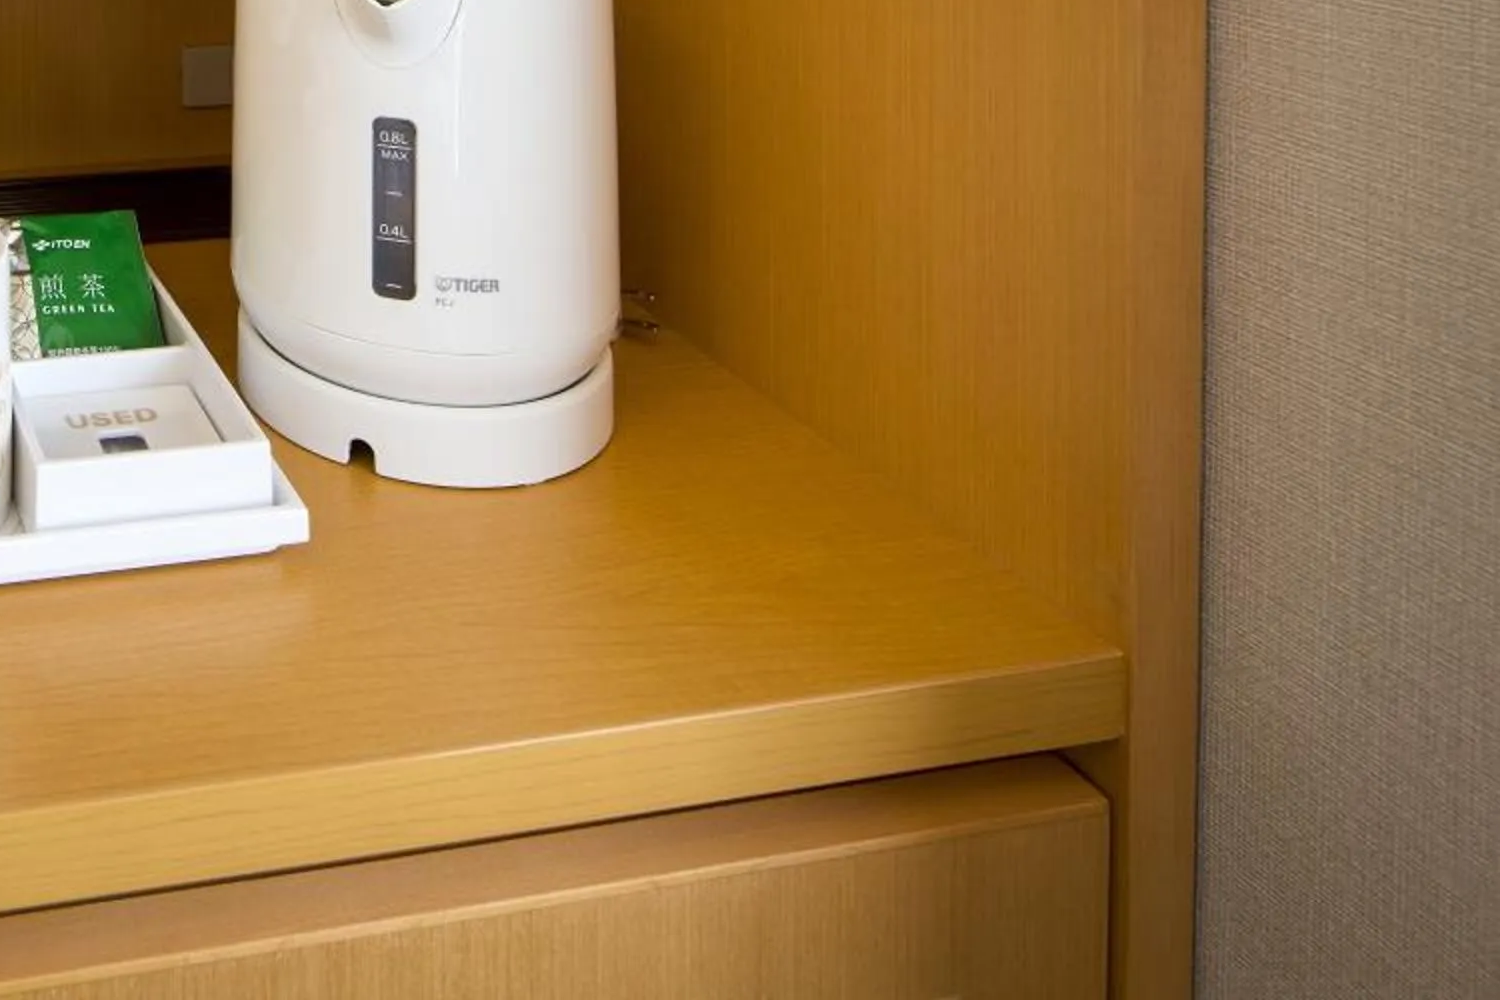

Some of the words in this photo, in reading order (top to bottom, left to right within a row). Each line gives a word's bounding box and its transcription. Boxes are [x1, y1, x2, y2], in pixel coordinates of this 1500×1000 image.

[379, 130, 409, 145] 0.8L
[380, 149, 410, 162] MAX
[379, 223, 408, 238] 0.4L
[455, 278, 500, 293] TIGER
[42, 305, 86, 315] GREEN
[92, 303, 116, 314] TEA
[65, 406, 158, 430] USED
